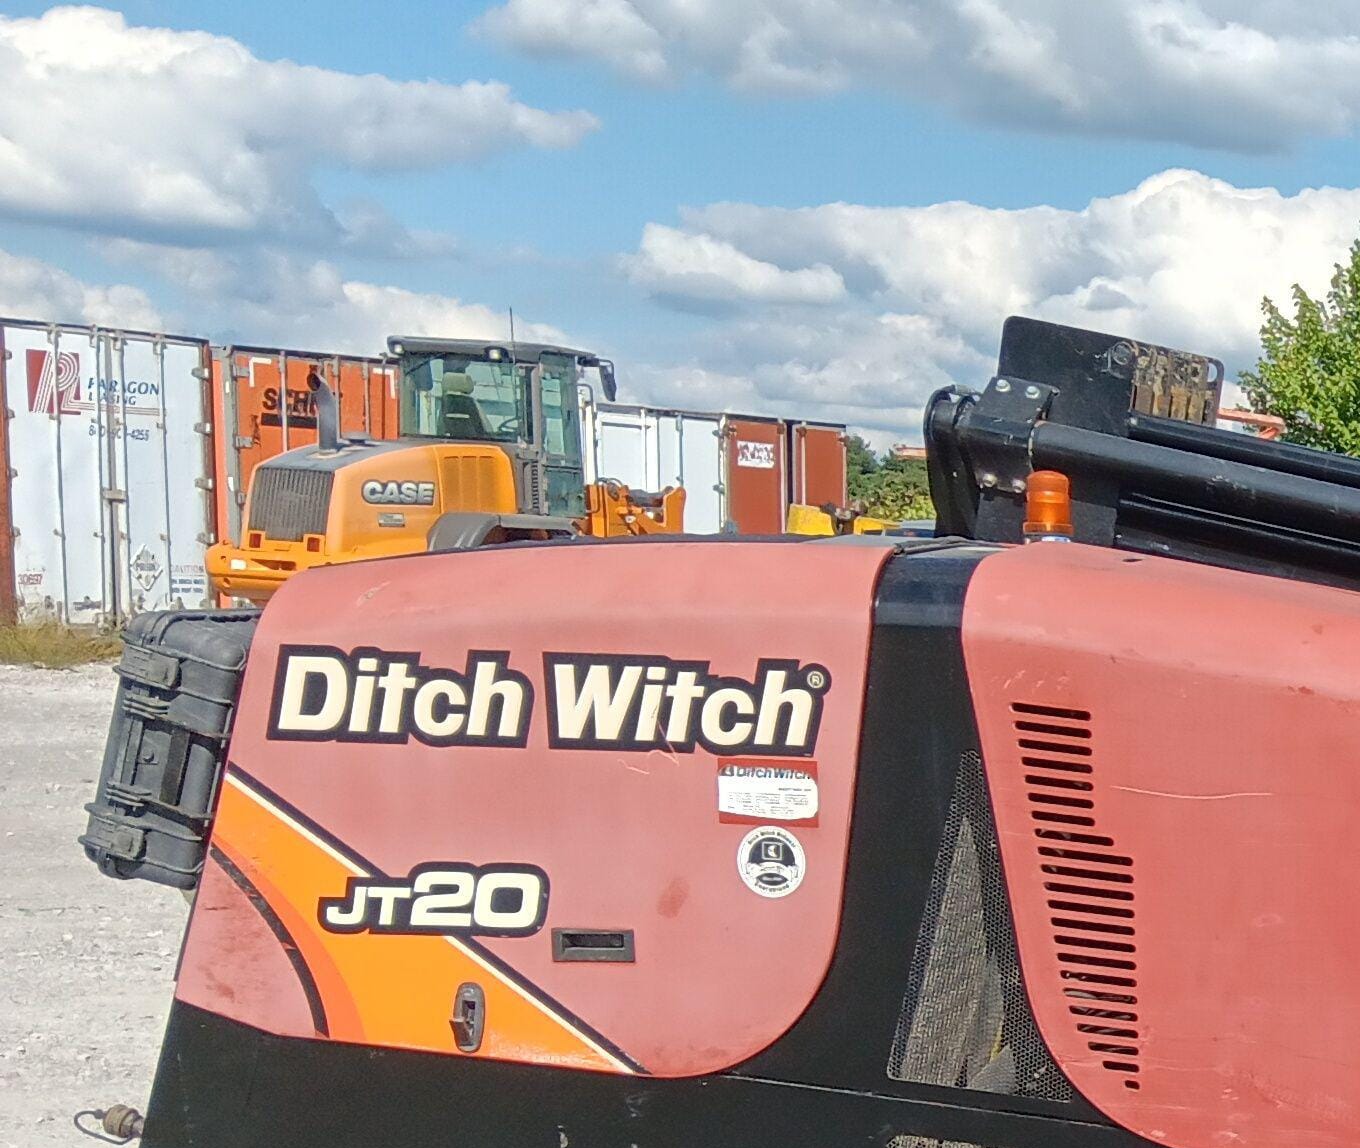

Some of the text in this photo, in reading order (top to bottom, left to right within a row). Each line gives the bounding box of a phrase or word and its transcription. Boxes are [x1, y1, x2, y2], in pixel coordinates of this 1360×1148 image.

[362, 480, 436, 505] CASE
[277, 655, 525, 738] Ditch
[326, 871, 540, 928] JT20
